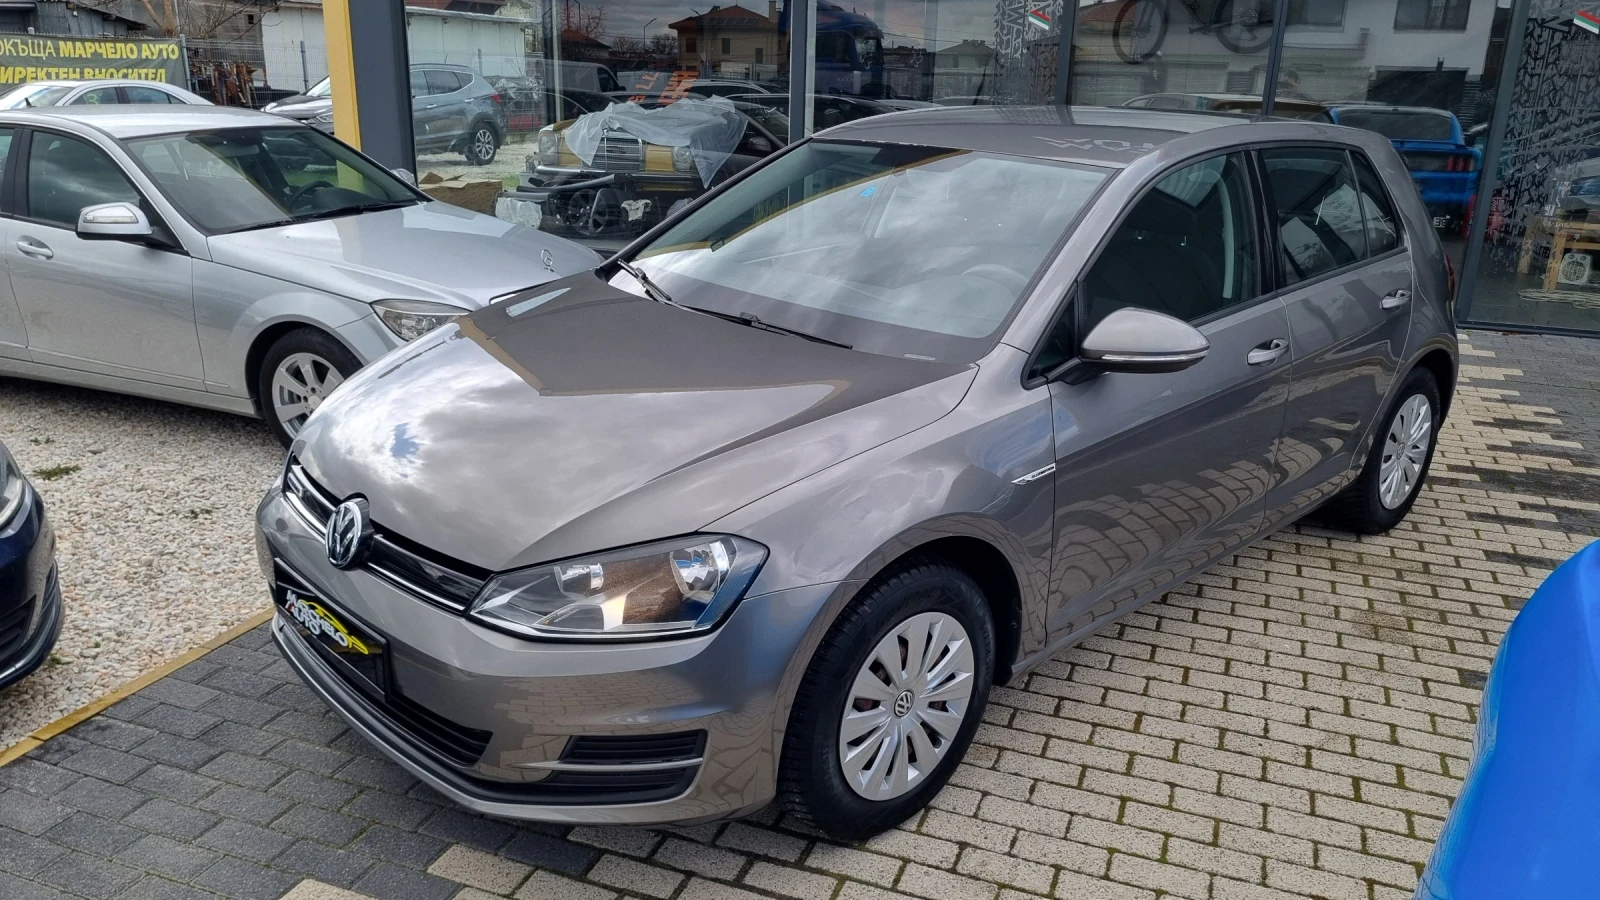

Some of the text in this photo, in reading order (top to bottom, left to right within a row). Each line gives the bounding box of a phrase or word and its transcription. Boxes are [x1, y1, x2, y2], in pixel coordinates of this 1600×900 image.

[59, 40, 138, 59] МАРЧЕЛО
[141, 43, 180, 60] АУТО
[285, 601, 320, 635] AUTO
[286, 590, 348, 647] MARCHELO
